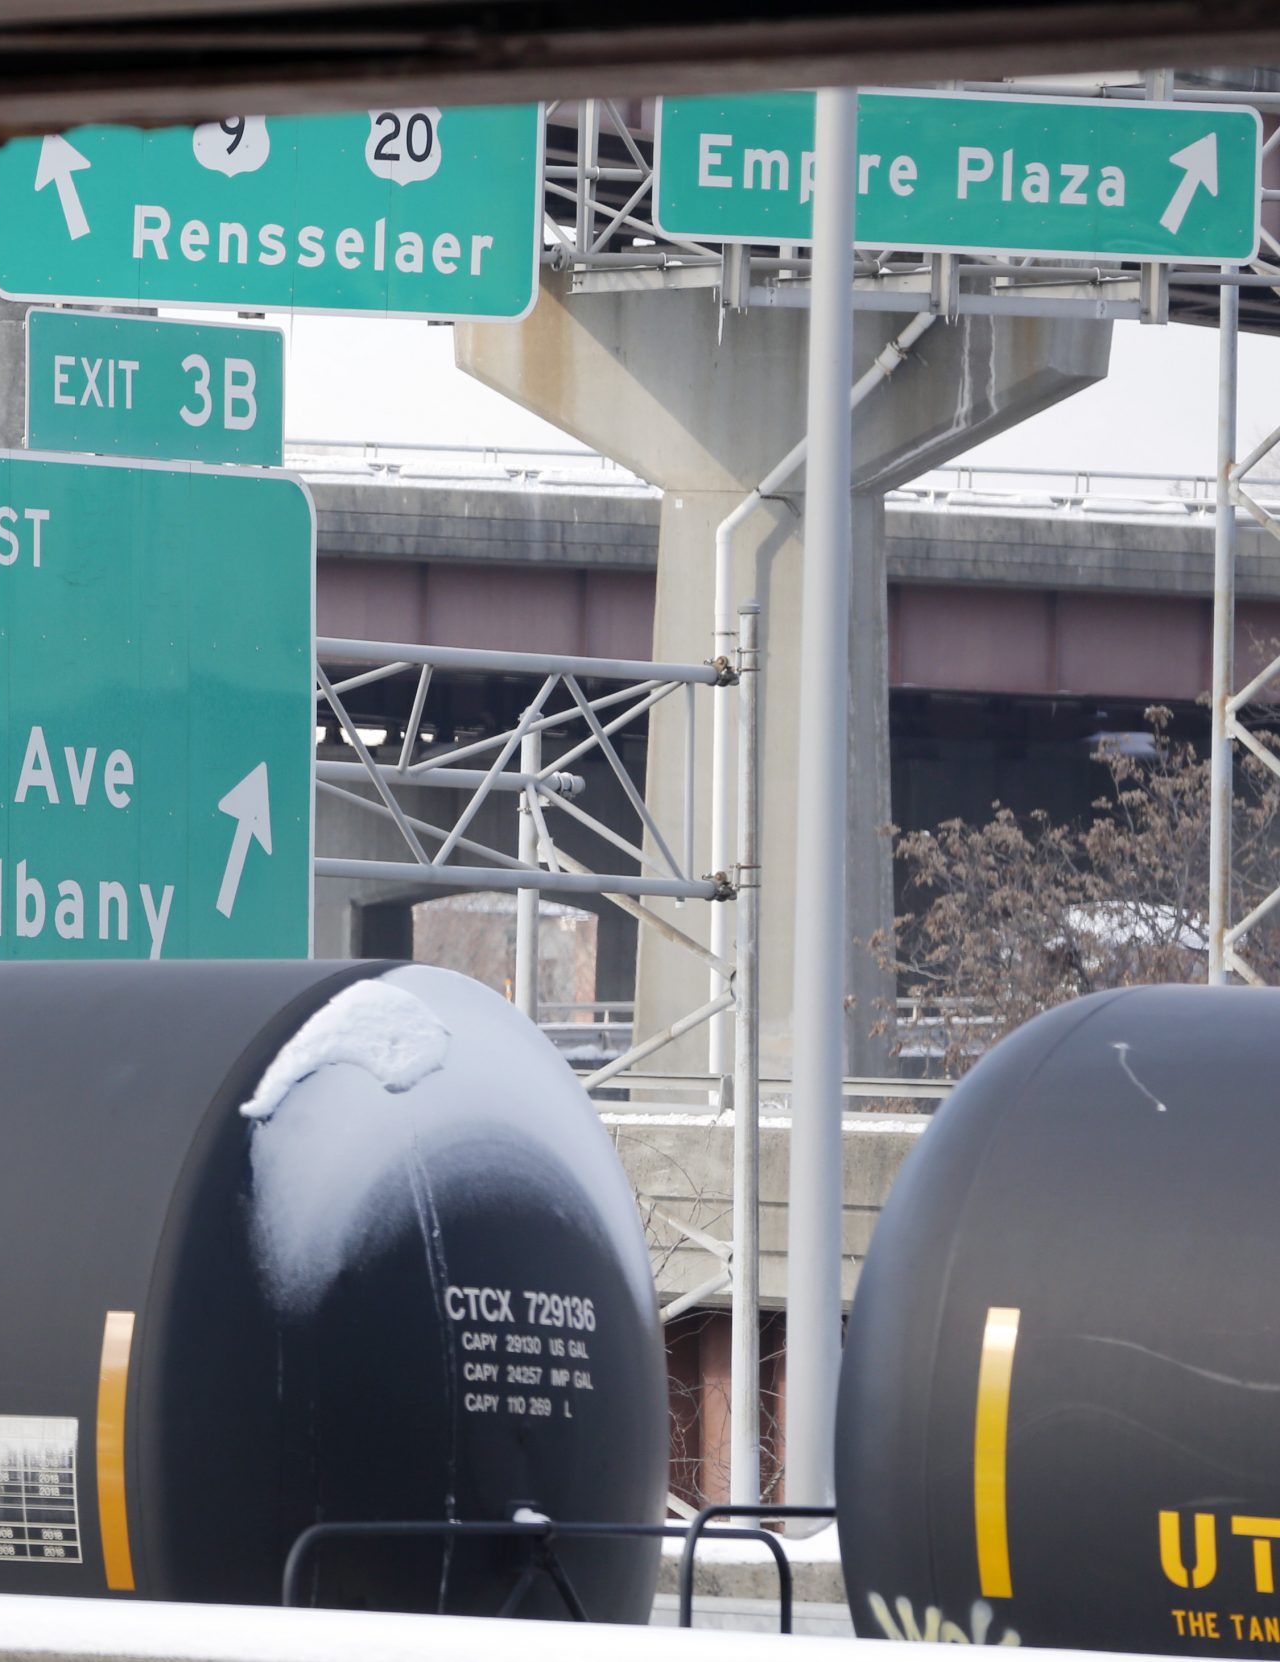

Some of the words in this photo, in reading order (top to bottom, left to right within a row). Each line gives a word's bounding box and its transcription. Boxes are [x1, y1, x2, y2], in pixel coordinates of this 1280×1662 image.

[220, 116, 245, 155] 9
[373, 112, 433, 162] 20
[698, 133, 918, 205] Empre
[957, 145, 1126, 207] Plaza
[132, 204, 494, 276] Rensselaer
[54, 354, 139, 410] EXIT
[179, 354, 257, 430] 3B
[14, 726, 135, 809] Ave
[444, 1285, 515, 1323] CTCX
[523, 1291, 596, 1332] 729136
[461, 1331, 498, 1352] CAPY
[505, 1334, 541, 1355] 29130
[548, 1338, 565, 1357] US
[568, 1339, 589, 1359] GAL
[463, 1362, 499, 1382] CAPY
[506, 1365, 543, 1385] 24257
[550, 1368, 570, 1387] IMP
[573, 1370, 594, 1390] GAL
[464, 1393, 499, 1412] CAPY
[507, 1396, 526, 1414] 110
[564, 1400, 573, 1418] L
[1171, 1609, 1220, 1639] THE
